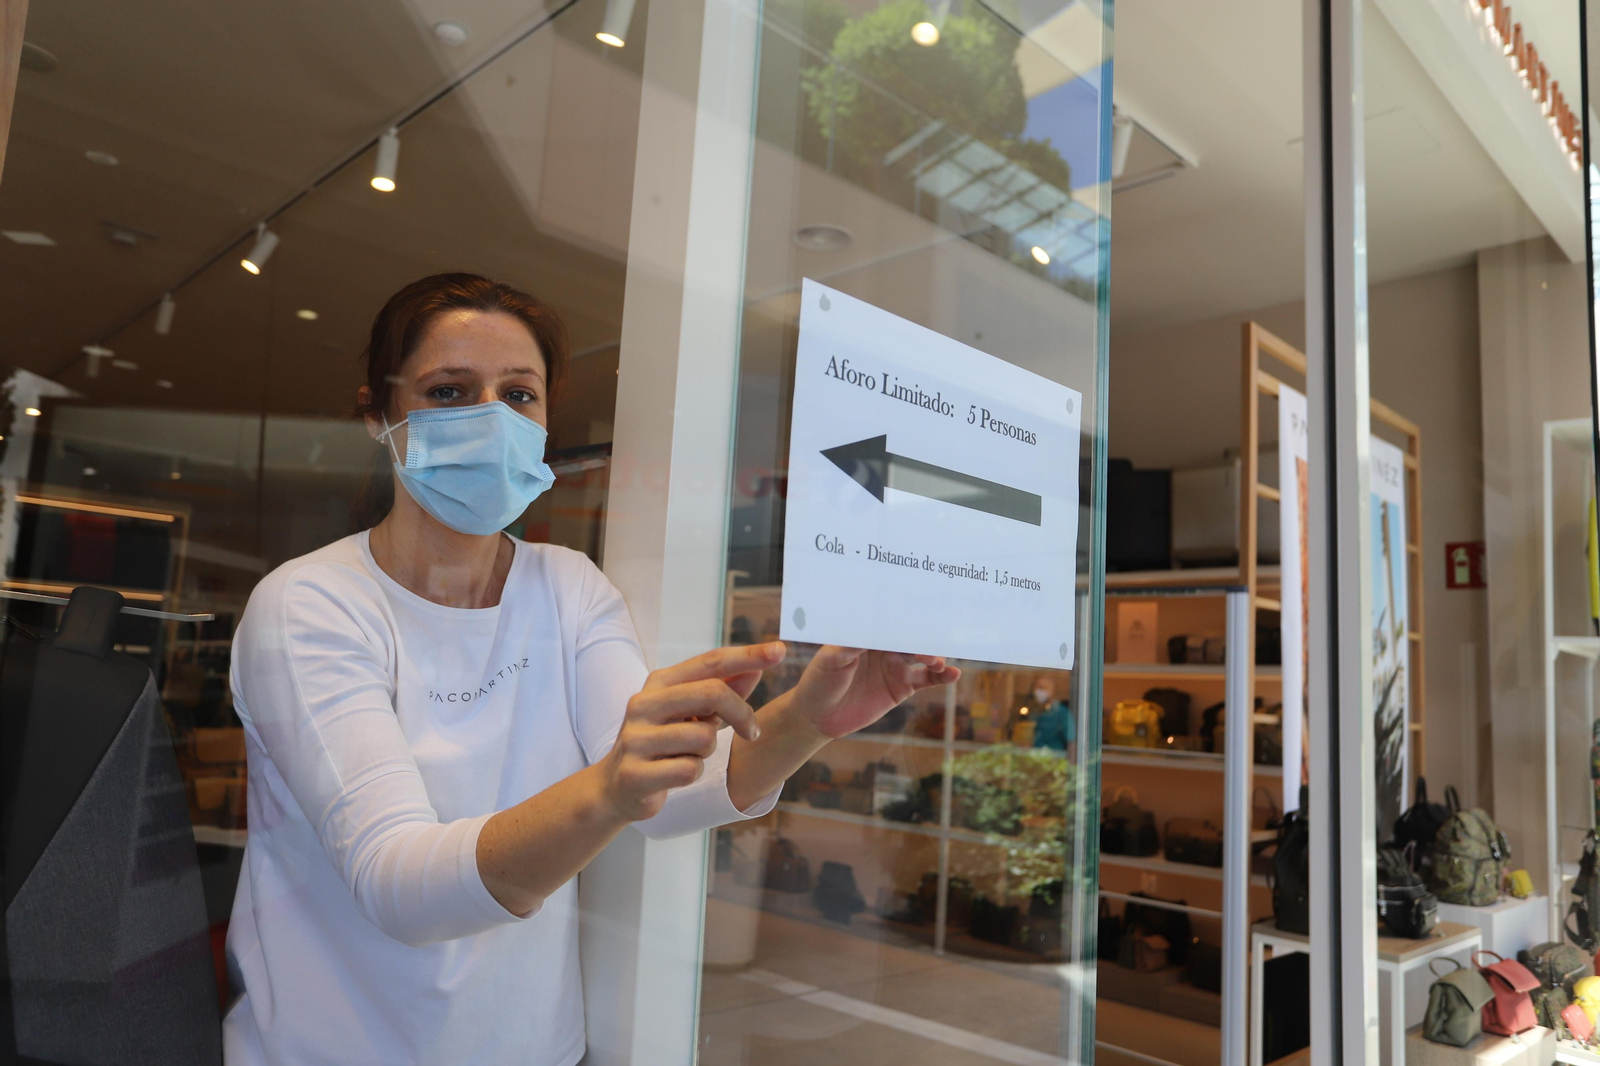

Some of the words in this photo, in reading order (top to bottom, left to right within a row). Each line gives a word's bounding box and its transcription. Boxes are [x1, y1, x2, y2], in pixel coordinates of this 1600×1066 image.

[824, 354, 877, 391] Aforo
[881, 372, 955, 418] Limitado:
[966, 403, 977, 425] 5
[980, 407, 1037, 446] Personas
[814, 533, 845, 556] Cola
[867, 543, 919, 569] Distancia
[922, 554, 936, 572] de
[938, 561, 989, 583] seguridad:
[994, 569, 1009, 588] 1,5
[1010, 573, 1041, 592] metros
